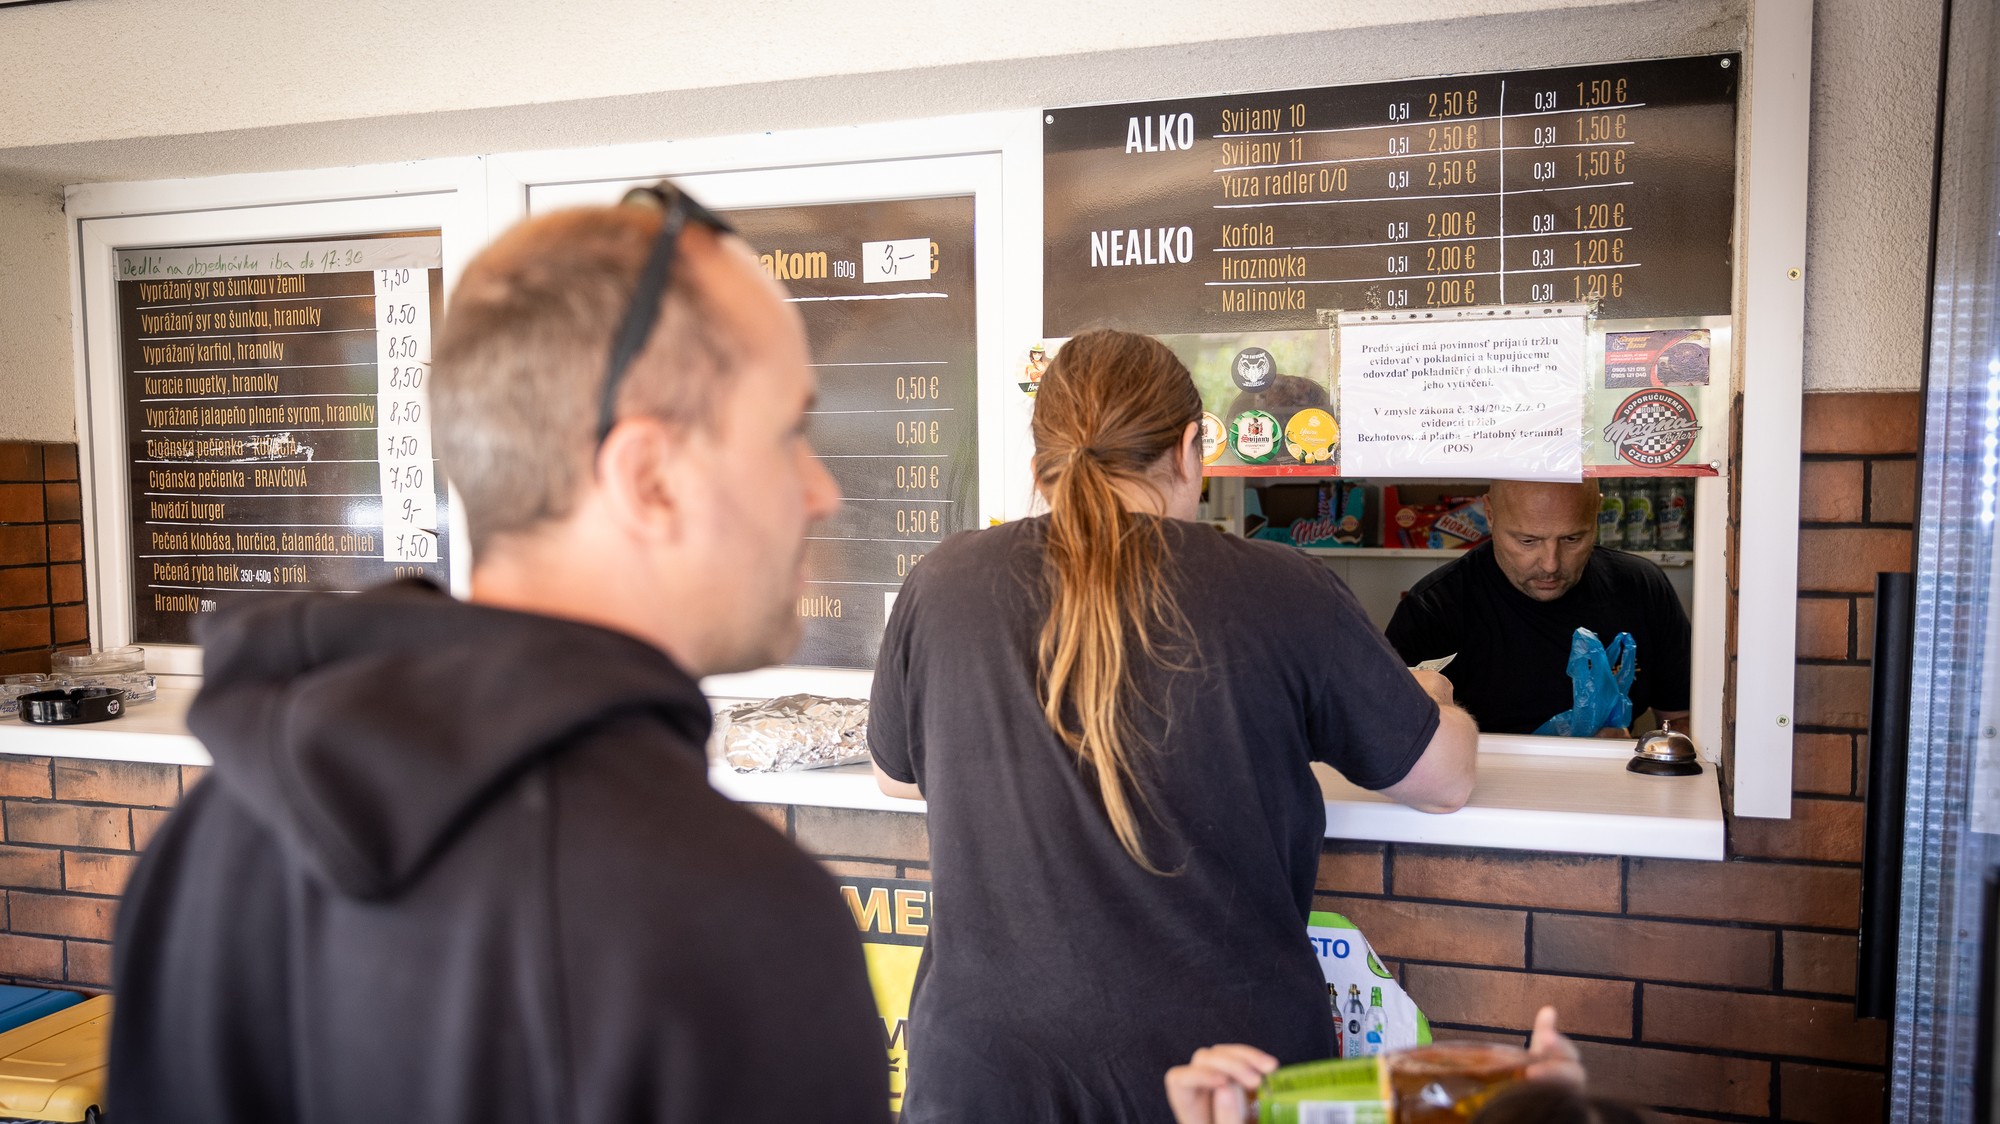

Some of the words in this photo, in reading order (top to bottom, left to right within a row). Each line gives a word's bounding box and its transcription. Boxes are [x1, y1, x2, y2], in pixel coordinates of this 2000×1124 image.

[1222, 107, 1281, 134] Svijany
[1289, 103, 1306, 128] 10
[1388, 102, 1410, 123] 0,5l
[1428, 91, 1463, 121] 2,50
[1466, 90, 1477, 115] €
[1534, 91, 1557, 112] 0,3l
[1576, 79, 1611, 109] 1,50
[1615, 78, 1627, 103] €
[1125, 113, 1195, 154] ALKO
[1222, 141, 1281, 166] Svijany
[1289, 137, 1303, 162] 11
[1388, 137, 1410, 157] 0,5l
[1428, 125, 1462, 155] 2,50
[1466, 125, 1477, 149] €
[1534, 127, 1556, 147] 0,3l
[1576, 115, 1611, 144] 1,50
[1615, 114, 1626, 139] €
[1222, 173, 1259, 199] Yuza
[1265, 171, 1315, 195] radler
[1319, 168, 1347, 193] 0/0
[1388, 171, 1409, 191] 0,5l
[1428, 161, 1462, 189] 2,50
[1466, 159, 1477, 184] €
[1533, 161, 1556, 182] 0,3l
[1575, 151, 1610, 181] 1,50
[1614, 149, 1626, 174] €
[1222, 223, 1274, 248] Kofola
[1387, 221, 1409, 242] 0,5l
[1427, 212, 1461, 240] 2,00
[1465, 211, 1476, 235] €
[1533, 214, 1555, 235] 0,3l
[1574, 204, 1609, 232] 1,20
[1613, 202, 1625, 228] €
[1090, 226, 1194, 268] NEALKO
[1222, 254, 1306, 280] Hroznovka
[1387, 255, 1408, 276] 0,5l
[1427, 246, 1461, 274] 2,00
[1464, 245, 1476, 270] €
[1532, 249, 1554, 269] 0,3l
[1574, 239, 1608, 268] 1,20
[1612, 238, 1624, 263] €
[166, 265, 183, 276] na
[187, 253, 258, 276] objednávku
[270, 252, 295, 270] iba
[300, 251, 315, 269] do
[832, 260, 856, 279] 160g
[140, 280, 192, 302] Vyprážaný
[194, 281, 210, 300] syr
[213, 281, 225, 297] so
[227, 275, 266, 296] šunkou
[268, 279, 275, 294] v
[277, 274, 306, 294] žemli
[1222, 288, 1306, 313] Malinovka
[1387, 289, 1408, 308] 0,5l
[1426, 281, 1460, 308] 2,00
[1464, 279, 1475, 304] €
[1612, 273, 1623, 298] €
[141, 311, 193, 334] Vyprážaný
[195, 314, 212, 332] syr
[214, 313, 227, 329] so
[229, 308, 272, 330] šunkou,
[274, 307, 321, 327] hranolky
[386, 304, 416, 326] 8,50
[143, 343, 195, 366] Vyprážaný
[197, 342, 236, 364] karfiol,
[237, 341, 284, 361] hranolky
[388, 335, 417, 359] 8,50
[1369, 356, 1413, 366] evidovať
[1423, 353, 1475, 366] pokladnici
[1487, 351, 1550, 362] kupujúcemu
[1422, 341, 1437, 351] má
[1440, 339, 1490, 353] povinnosť
[145, 376, 183, 395] Kuracie
[185, 375, 231, 396] nugetky,
[232, 373, 279, 394] hranolky
[390, 366, 423, 390] 8,50
[1362, 368, 1409, 379] odovzdať
[1423, 380, 1444, 392] jeho
[896, 376, 927, 403] 0,50
[929, 376, 940, 400] €
[146, 406, 199, 428] Vyprážané
[201, 406, 246, 427] jalapeňo
[249, 404, 285, 426] plnené
[287, 405, 324, 426] syrom,
[326, 403, 375, 424] hranolky
[390, 401, 421, 425] 8,50
[1373, 407, 1382, 416] V
[1384, 406, 1417, 418] zmysle
[1419, 406, 1454, 415] zákona
[1623, 393, 1684, 415] DOPORUČUJEME!
[896, 420, 927, 447] 0,50
[929, 420, 940, 444] €
[1604, 416, 1699, 460] Magna
[197, 437, 244, 458] pečienka
[388, 436, 418, 459] 7,50
[1443, 443, 1474, 454] (POS)
[1628, 449, 1662, 464] CZECH
[1664, 443, 1686, 461] REP.
[149, 469, 196, 491] Cigánska
[198, 469, 245, 490] pečienka
[255, 466, 308, 488] BRAVČOVÁ
[390, 465, 423, 493] 7,50
[896, 465, 927, 492] 0,50
[929, 465, 940, 489] €
[151, 501, 189, 519] Hovädzí
[191, 501, 225, 521] burger
[896, 510, 927, 536] 0,50
[929, 510, 940, 533] €
[152, 531, 189, 550] Pečená
[190, 532, 235, 554] klobása,
[236, 532, 280, 554] horčica,
[281, 532, 339, 554] čalamáda,
[341, 533, 374, 552] chlieb
[396, 534, 429, 560] 7,50
[153, 562, 190, 581] Pečená
[191, 563, 215, 583] ryba
[217, 563, 240, 582] heik
[240, 569, 272, 584] 350-450g
[282, 564, 311, 584] prísl.
[155, 594, 199, 614] Hranolky
[840, 886, 934, 936] ME
